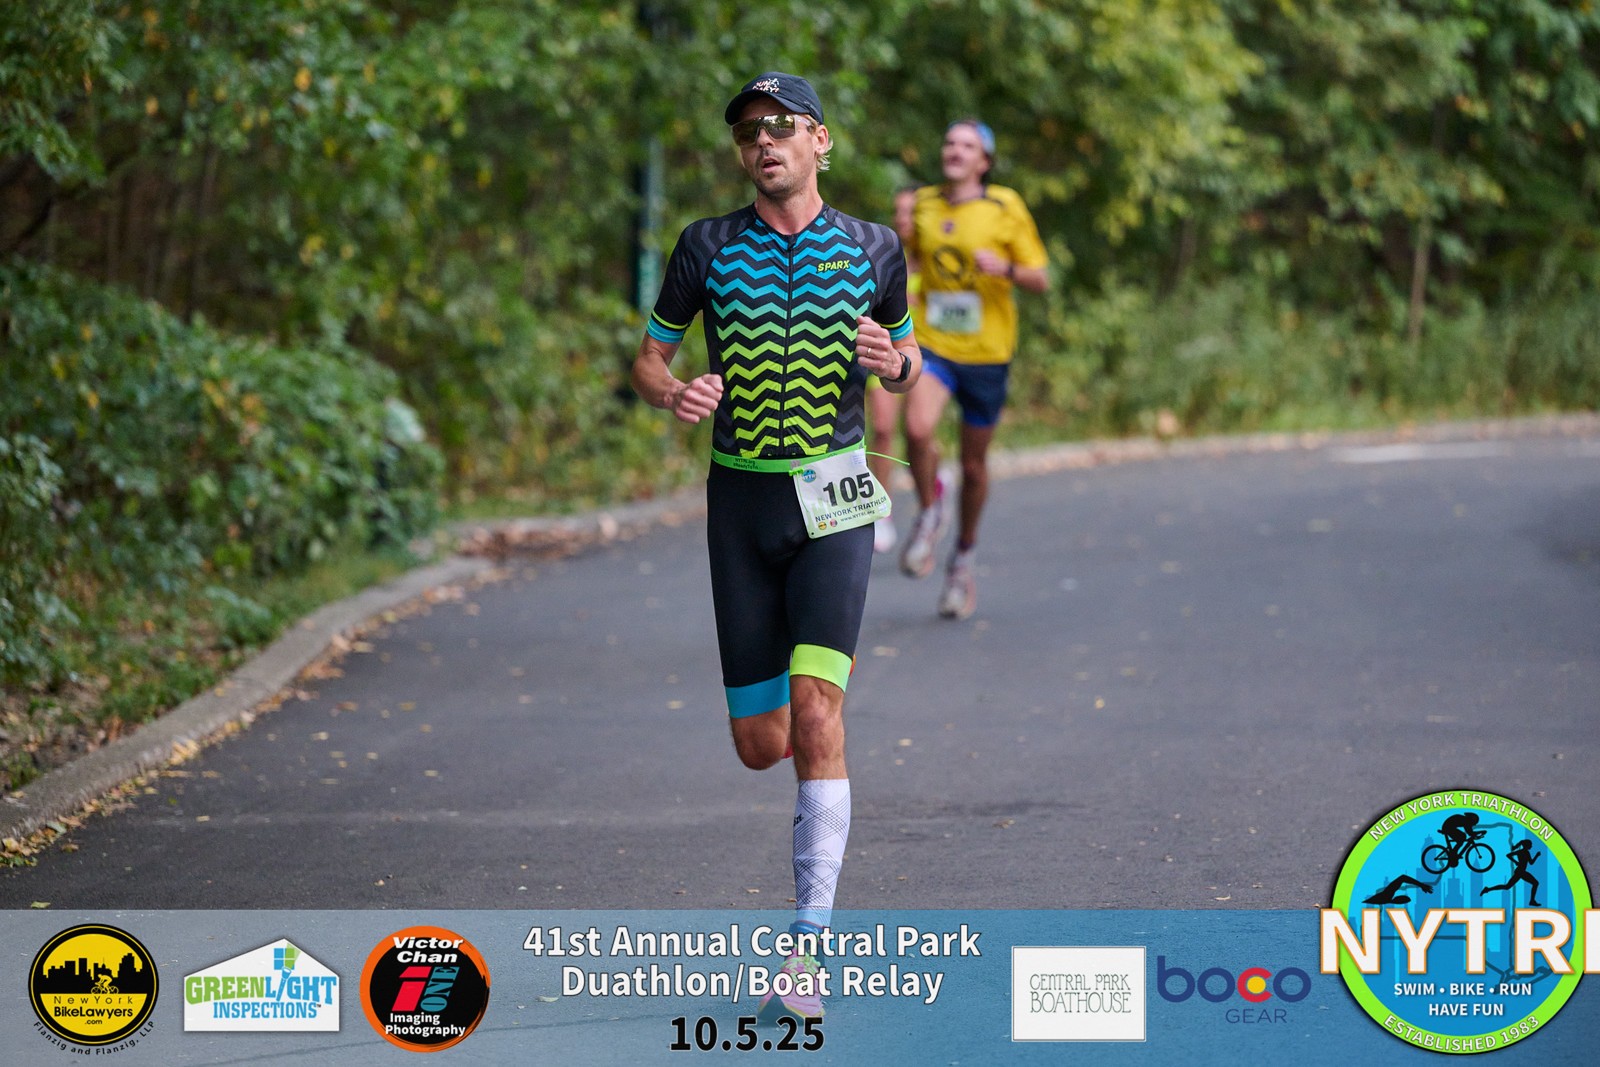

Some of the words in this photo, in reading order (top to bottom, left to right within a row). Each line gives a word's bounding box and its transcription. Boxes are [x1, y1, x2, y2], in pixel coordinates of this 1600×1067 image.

[817, 260, 850, 272] SPARX
[823, 472, 874, 507] 105
[815, 513, 831, 523] NEW
[832, 508, 853, 518] YORK
